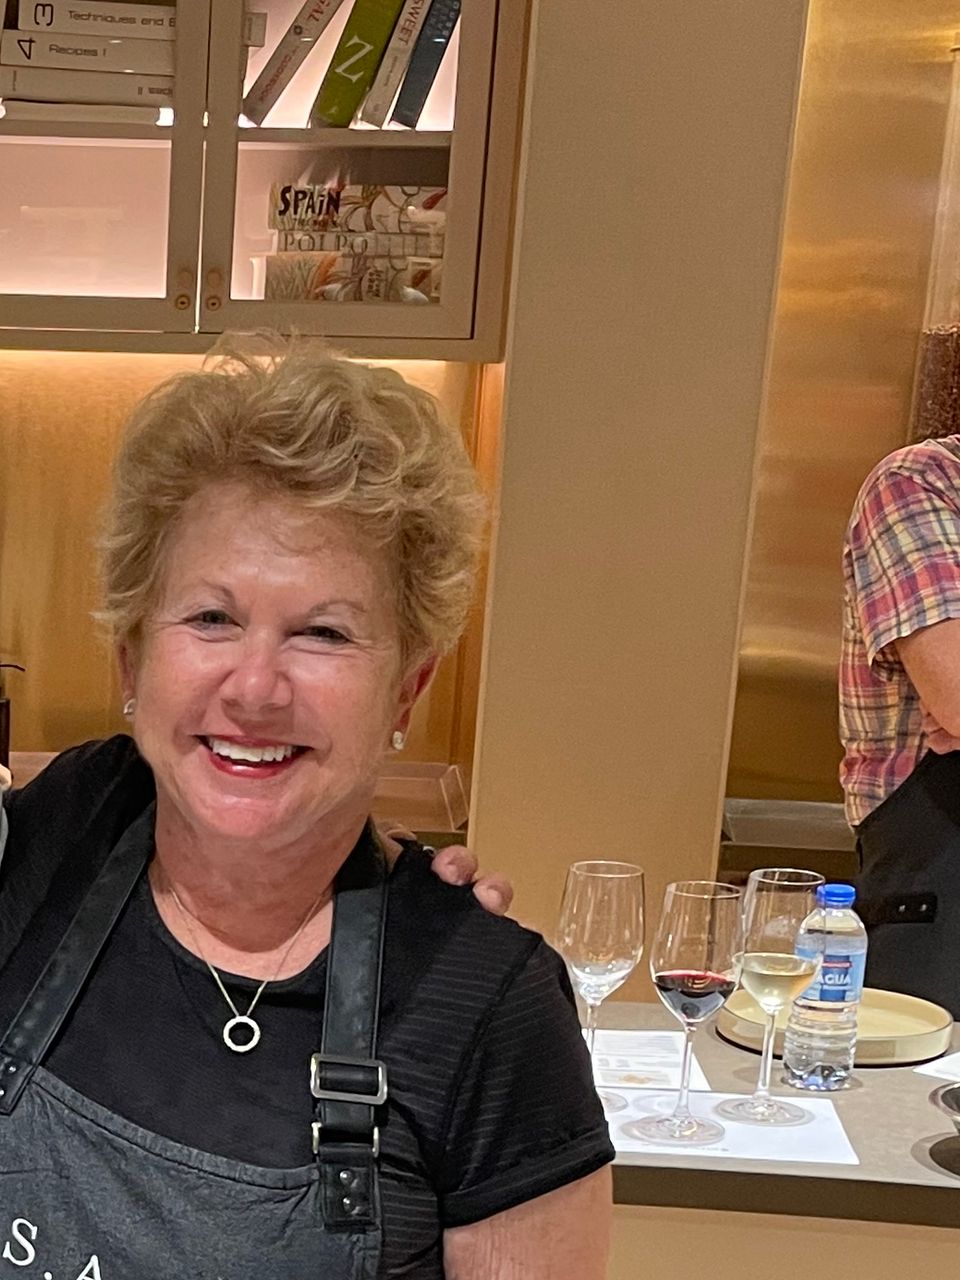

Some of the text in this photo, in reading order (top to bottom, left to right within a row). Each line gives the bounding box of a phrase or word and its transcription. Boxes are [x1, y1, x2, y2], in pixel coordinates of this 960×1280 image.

[34, 3, 54, 26] 3
[68, 10, 137, 25] Techniques
[141, 17, 164, 27] and
[17, 37, 36, 60] 4
